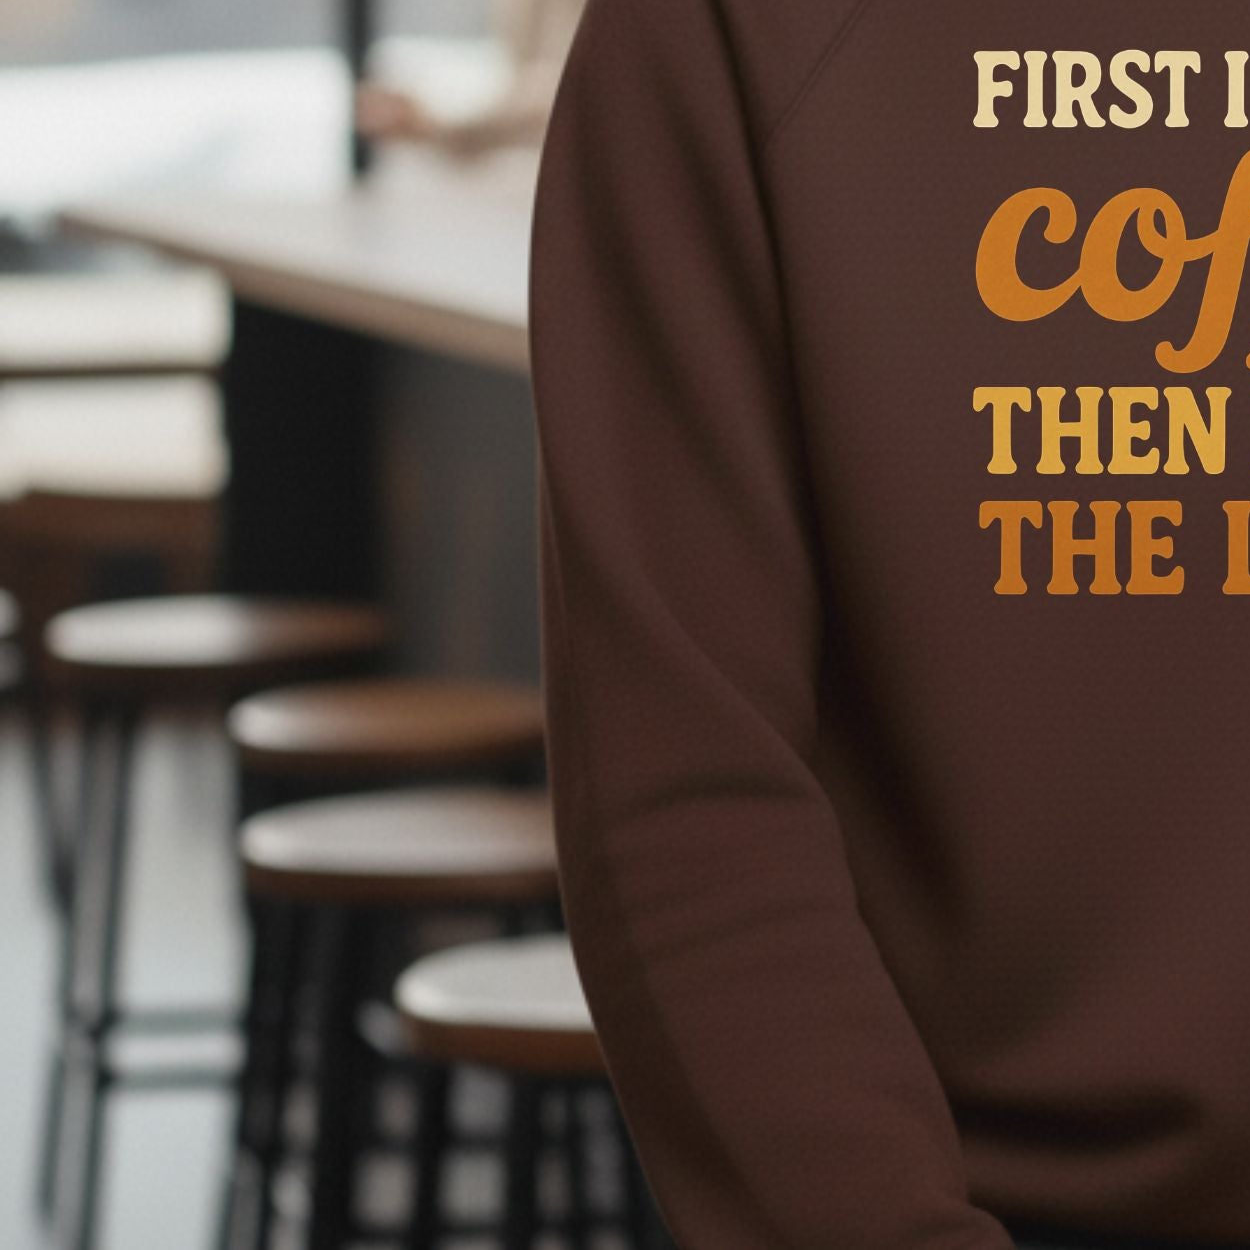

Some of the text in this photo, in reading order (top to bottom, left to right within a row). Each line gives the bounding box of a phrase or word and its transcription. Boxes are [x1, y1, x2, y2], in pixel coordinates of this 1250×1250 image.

[973, 50, 1201, 128] FIRST
[1224, 51, 1249, 127] I
[973, 386, 1232, 475] THEN
[979, 500, 1184, 595] THE
